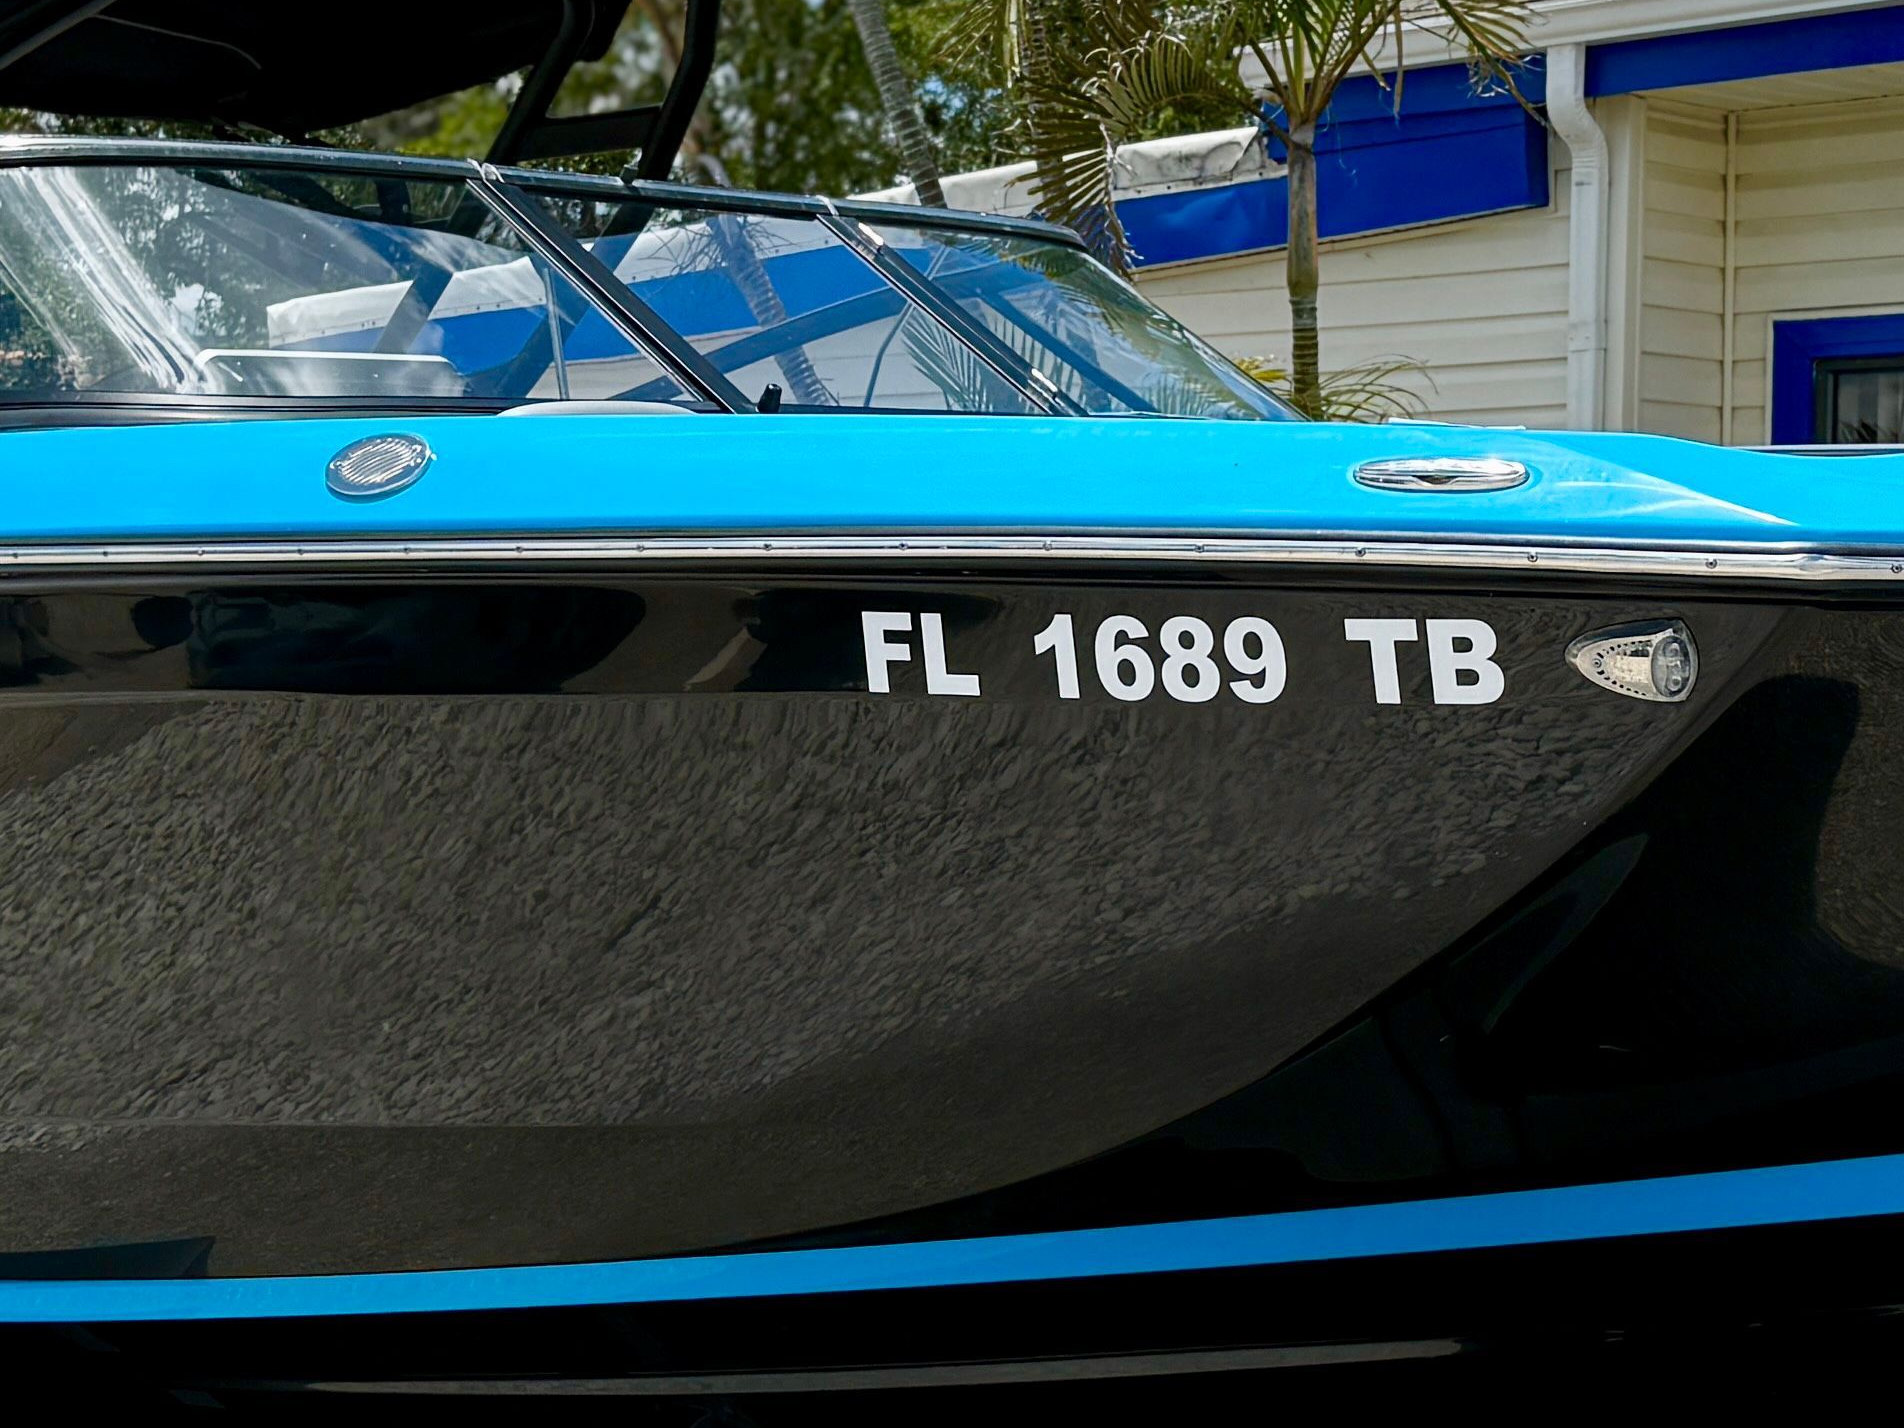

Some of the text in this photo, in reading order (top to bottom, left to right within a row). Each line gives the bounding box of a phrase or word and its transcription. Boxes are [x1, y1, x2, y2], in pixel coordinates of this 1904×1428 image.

[862, 611, 1506, 705] FL 1689 TB
